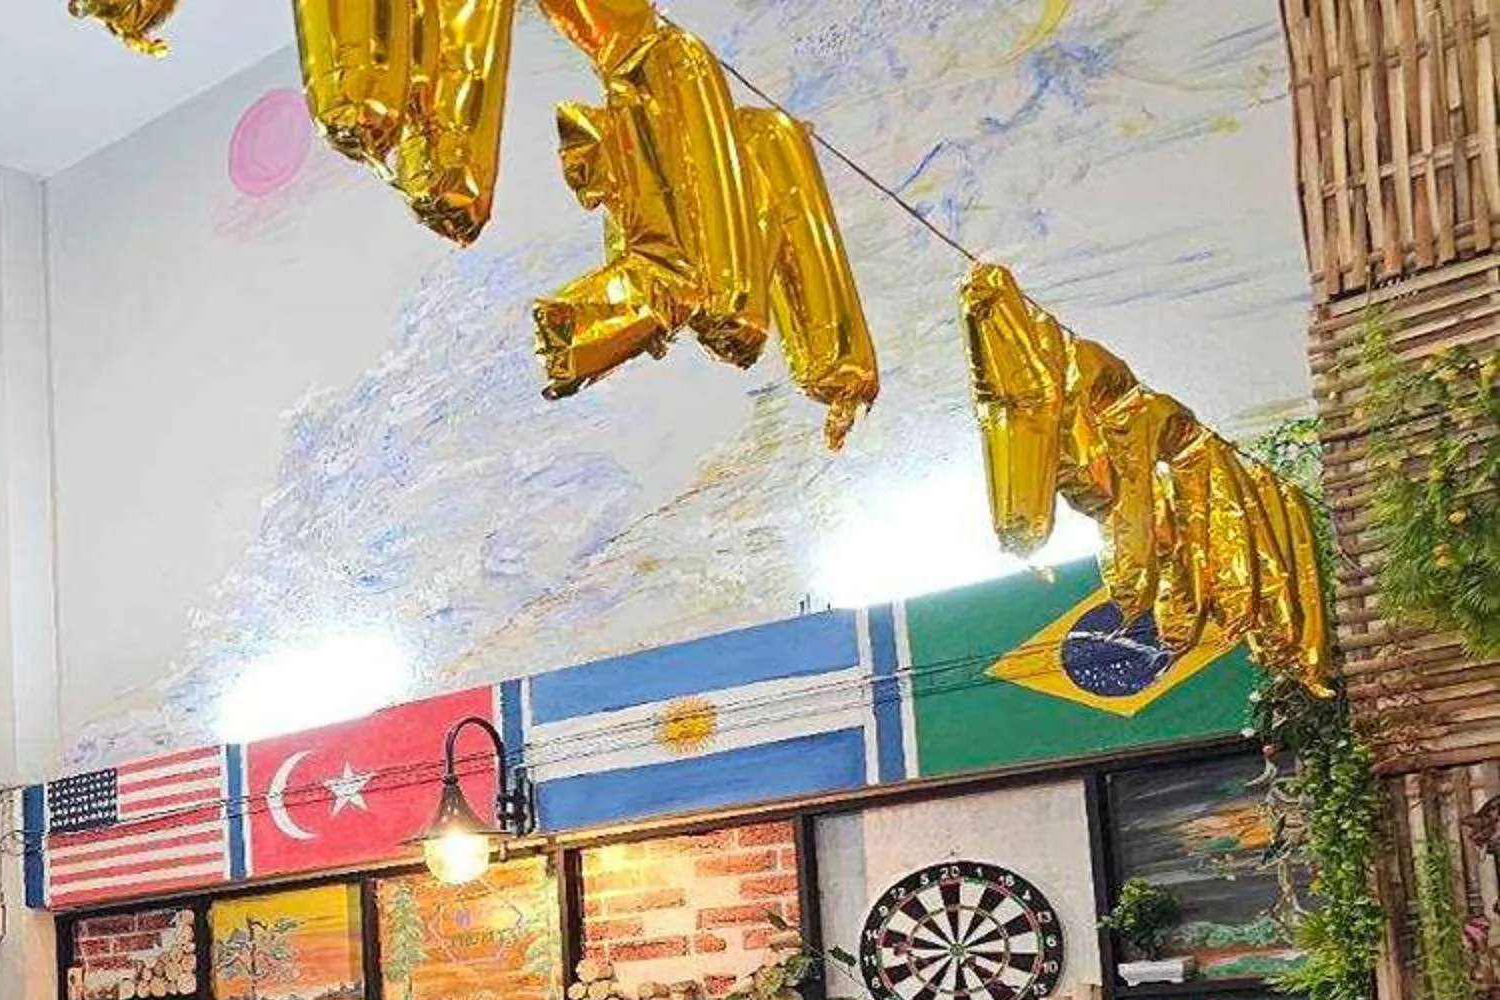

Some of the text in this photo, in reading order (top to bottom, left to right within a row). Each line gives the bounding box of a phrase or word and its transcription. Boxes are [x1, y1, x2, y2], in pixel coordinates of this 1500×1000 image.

[939, 865, 960, 880] 20
[920, 873, 930, 885] 5
[878, 905, 889, 917] 9
[1046, 934, 1057, 947] 6
[863, 954, 877, 966] 11
[1042, 959, 1059, 974] 10
[1033, 983, 1048, 995] 15
